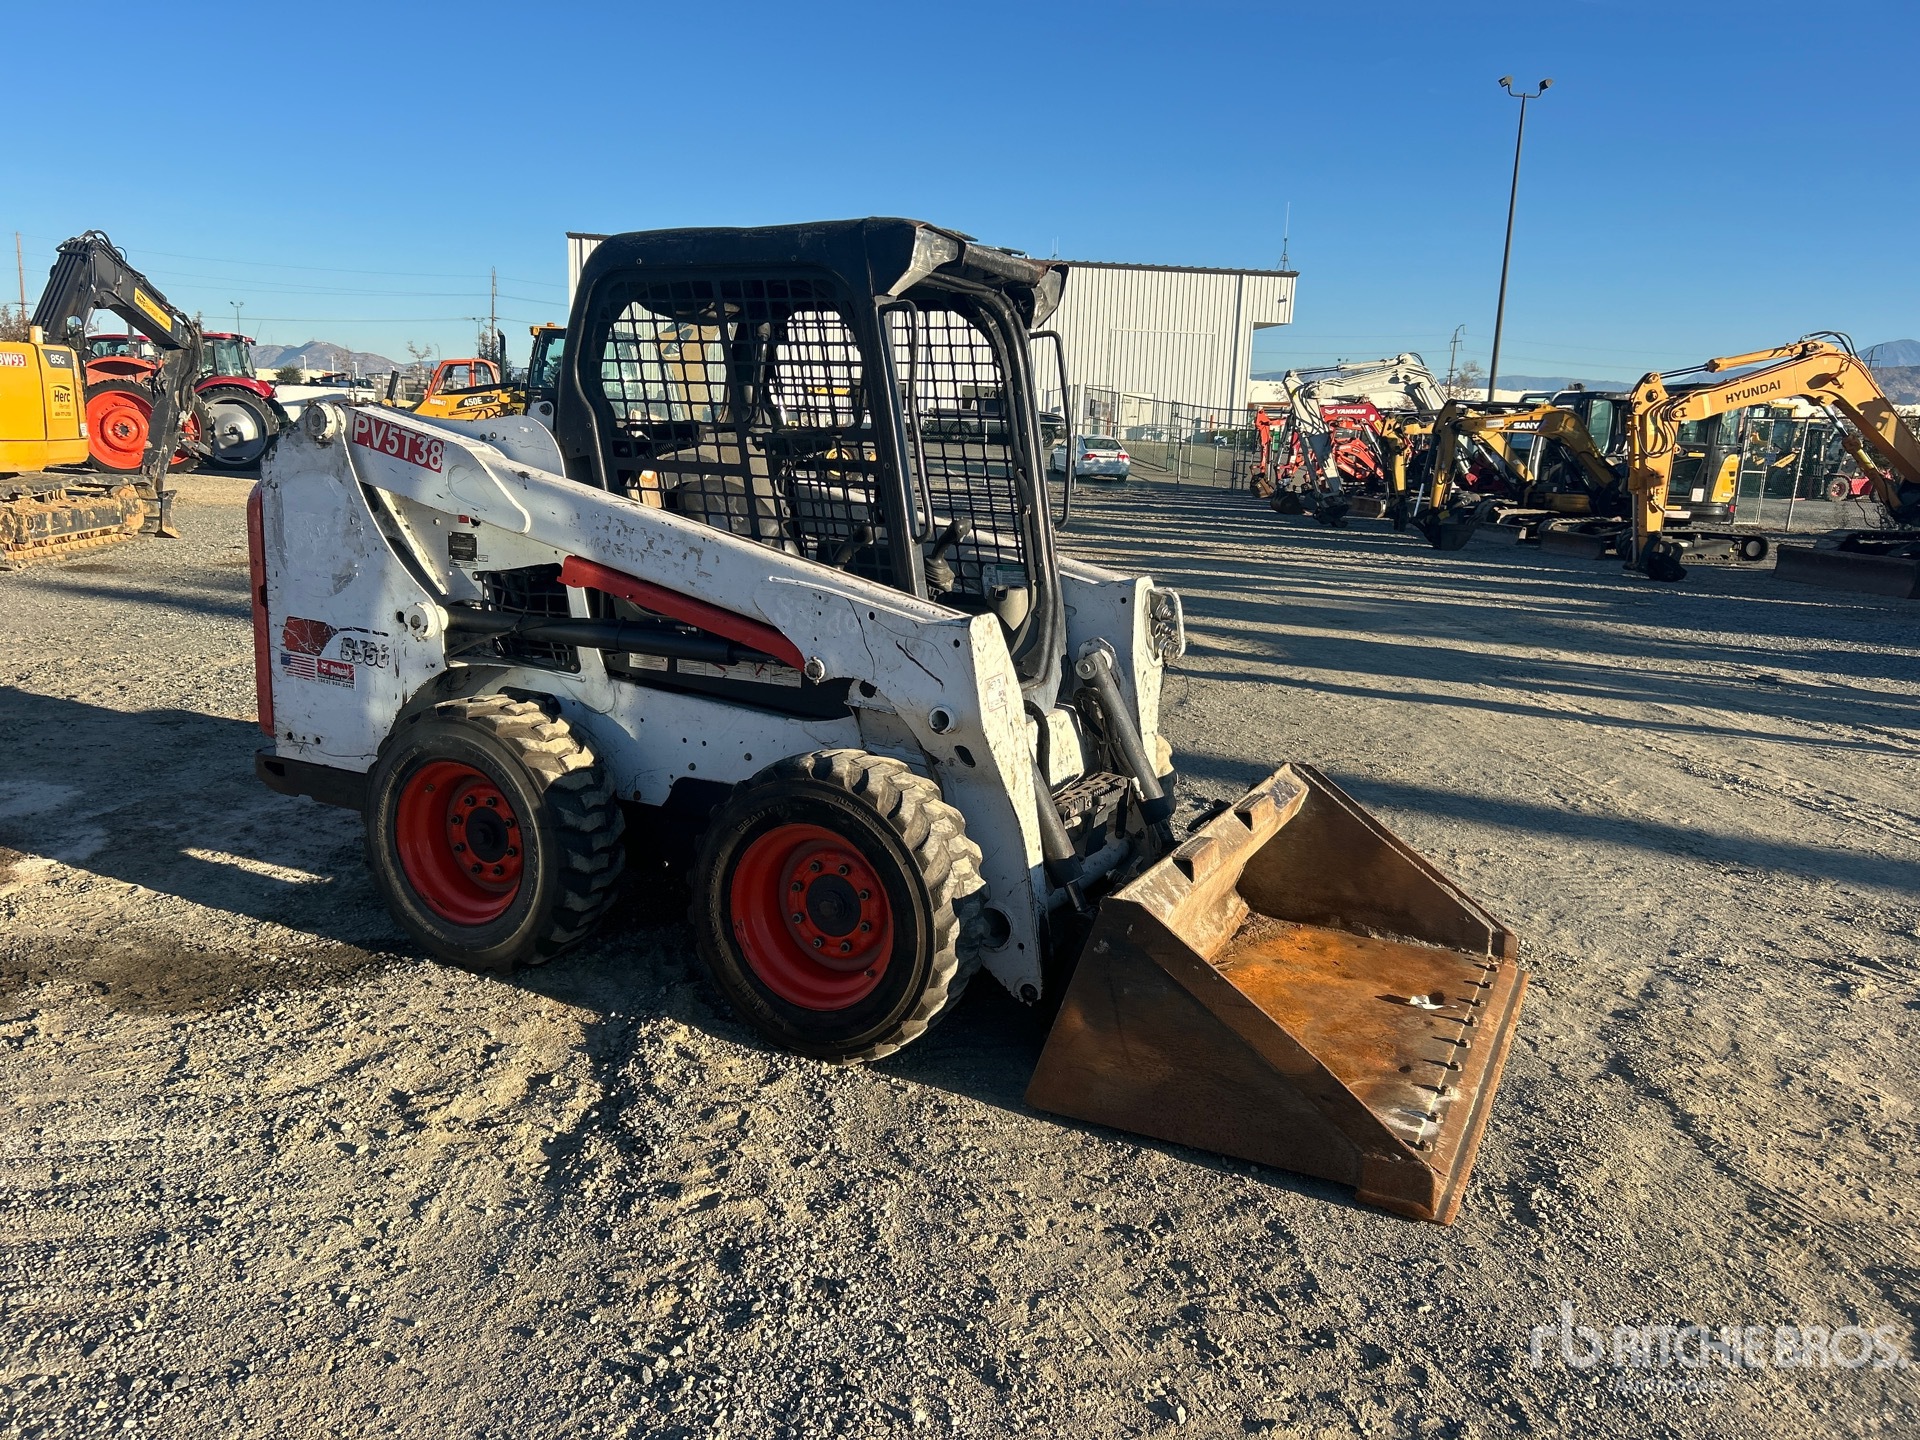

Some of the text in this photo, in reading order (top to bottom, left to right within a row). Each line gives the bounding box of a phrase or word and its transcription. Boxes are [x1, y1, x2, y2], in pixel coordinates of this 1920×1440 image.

[50, 353, 65, 365] 85G
[53, 390, 71, 403] Herc
[1725, 380, 1781, 404] HYUNDAI
[463, 396, 483, 407] 450E
[1513, 422, 1540, 430] SANY
[353, 414, 443, 470] PV5T38
